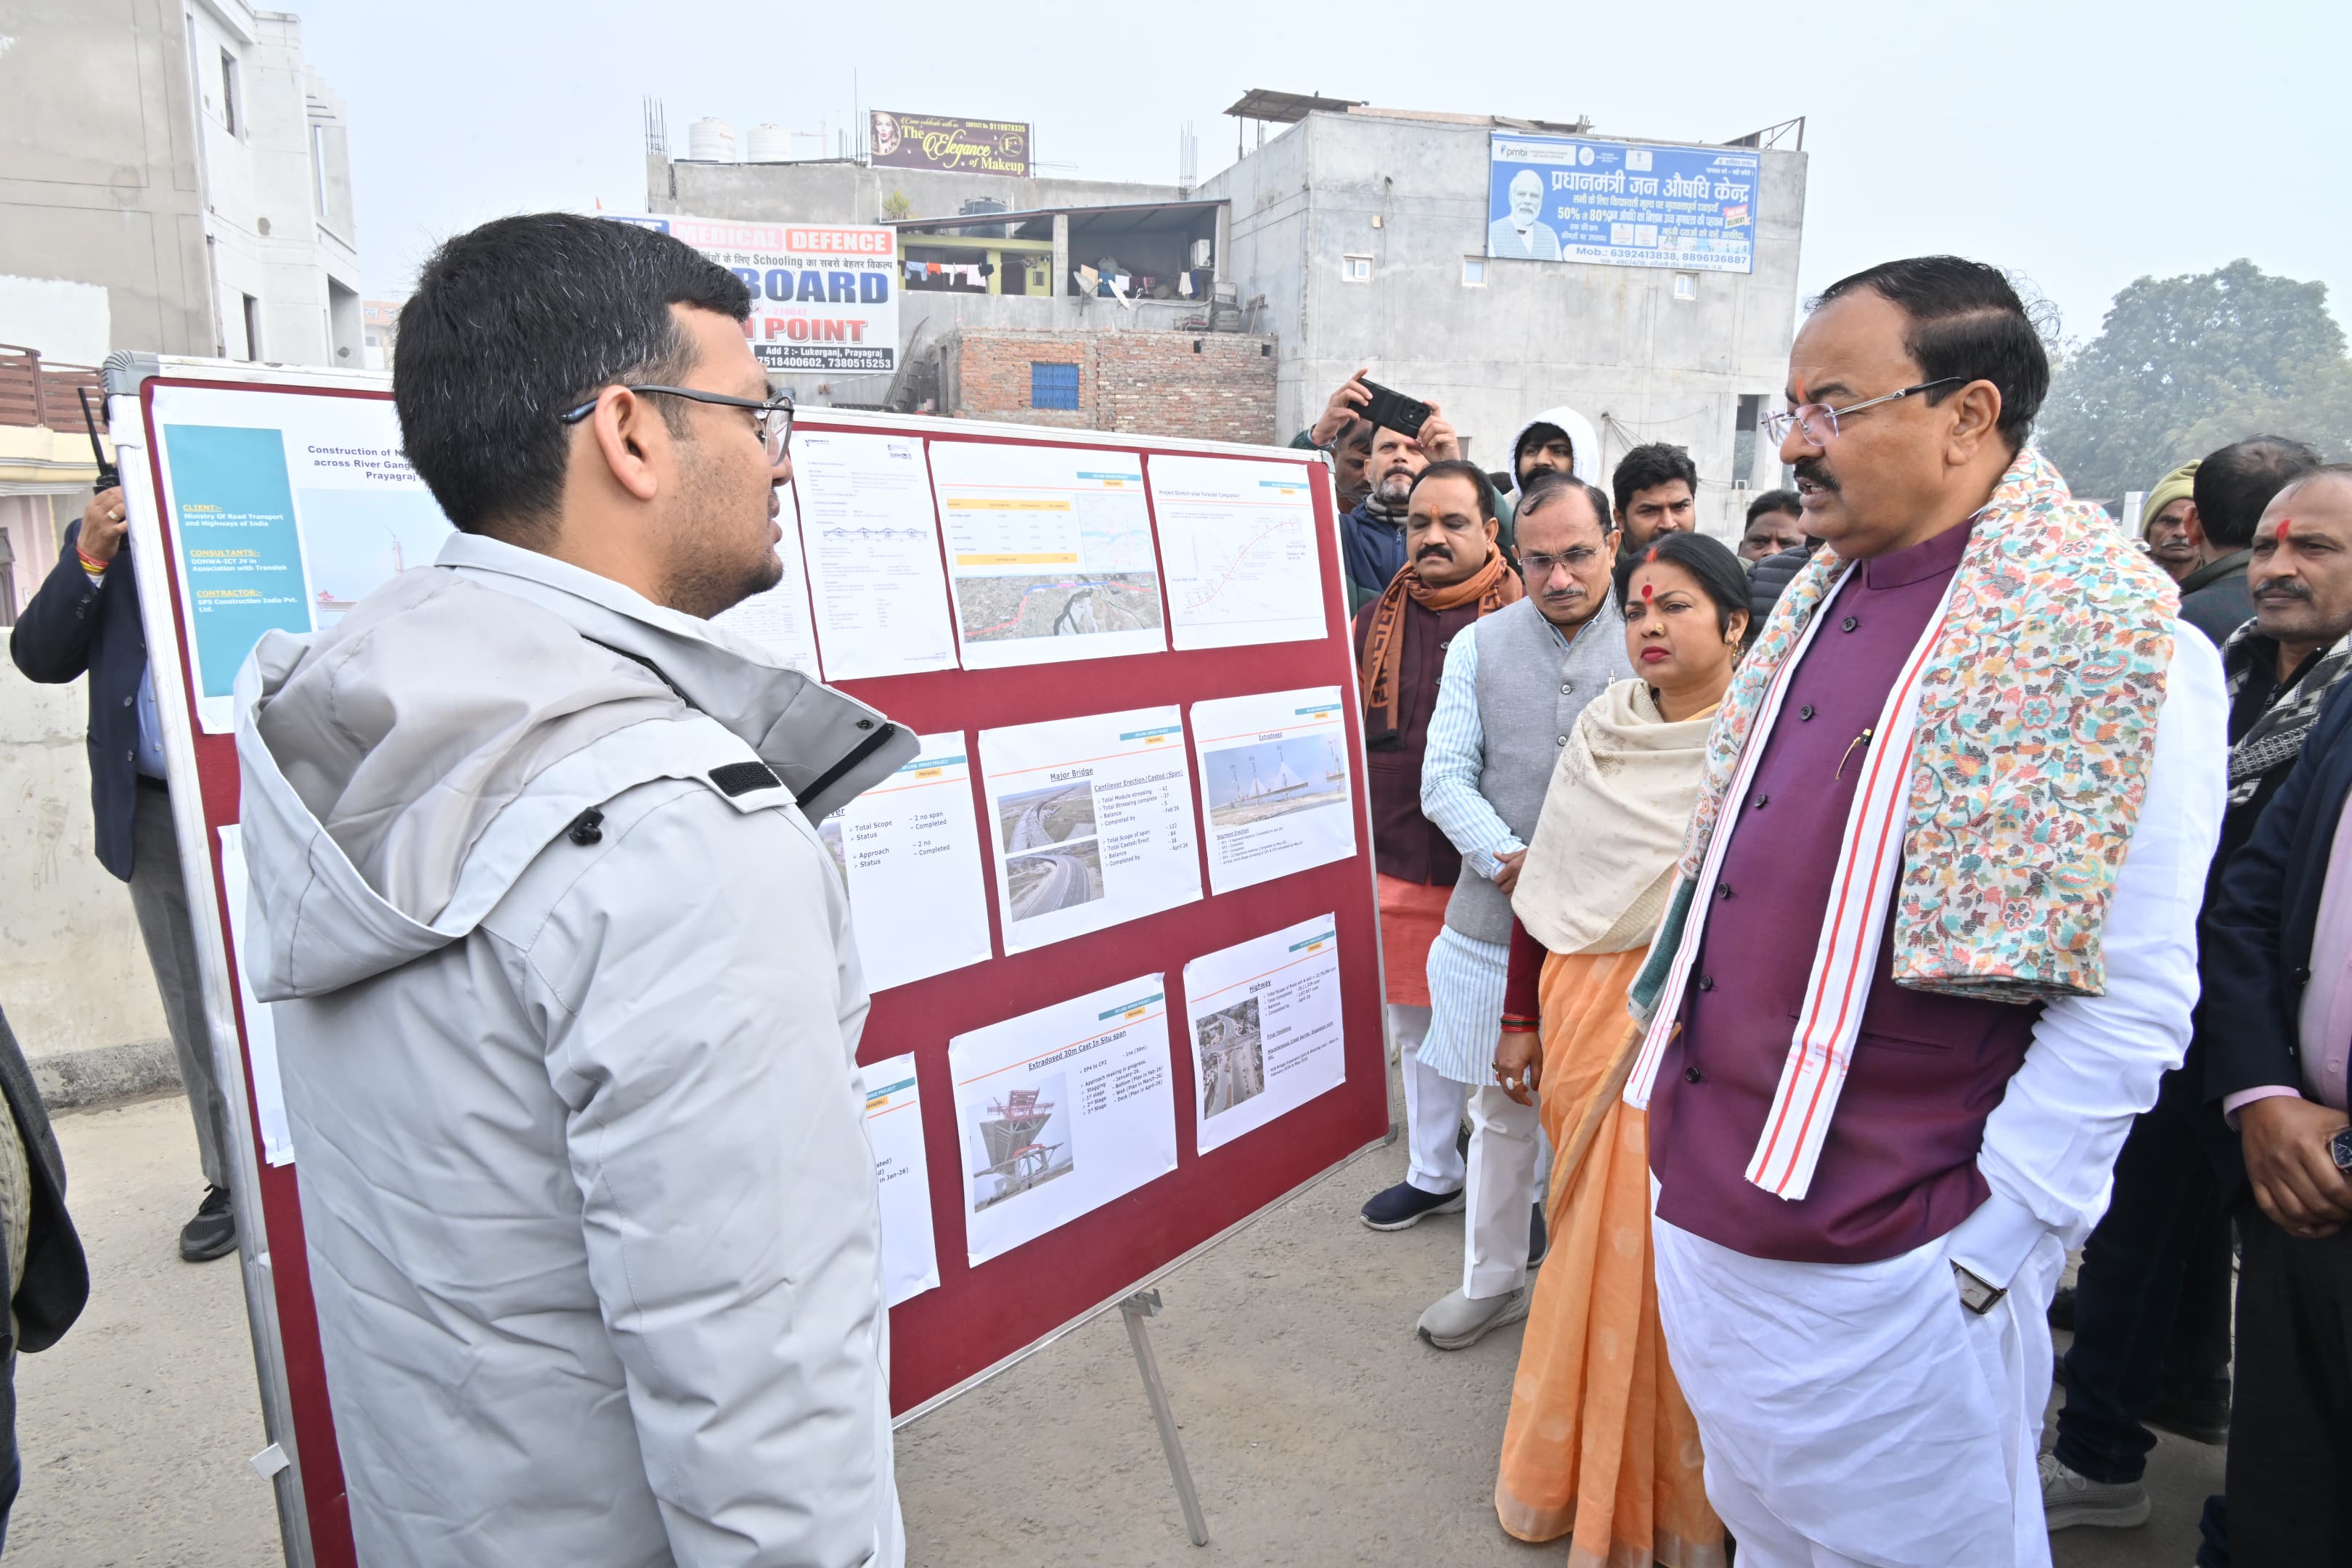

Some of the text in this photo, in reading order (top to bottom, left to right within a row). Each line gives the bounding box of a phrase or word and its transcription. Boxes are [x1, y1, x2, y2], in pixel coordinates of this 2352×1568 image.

[902, 126, 924, 139] The
[923, 129, 991, 168] Elegance
[1506, 147, 1527, 158] pmbi
[970, 157, 1024, 173] of Makeup
[1551, 170, 1625, 194] प्रधानमंत्री
[1629, 177, 1658, 196] जन
[1663, 172, 1710, 199] औषधि
[1558, 207, 1612, 221] 50% 80%
[673, 222, 779, 248] MEDICAL
[792, 232, 886, 252] DEFENCE
[735, 256, 750, 264] लिए
[754, 254, 802, 268] Schooling
[806, 258, 817, 267] का
[820, 258, 839, 267] सबसे
[844, 258, 864, 269] बेहतर
[868, 259, 892, 269] विकल्प
[1683, 253, 1747, 264] 8896136887
[732, 267, 888, 303] BOARD
[764, 318, 867, 343] POINT
[801, 348, 842, 358] Lukerganj,
[845, 348, 882, 358] Prayagraj
[758, 356, 891, 368] 7518400602, 7380515253
[308, 446, 377, 456] Construction
[384, 461, 412, 470] Gang
[367, 472, 416, 481] Prayagraj
[1259, 732, 1283, 741] Extradosed
[1050, 767, 1093, 782] Major Bridge
[1094, 781, 1122, 791] Cantilever
[855, 823, 871, 832] Total
[873, 820, 892, 830] Scope
[929, 811, 943, 820] span
[1105, 817, 1129, 826] Completed
[857, 818, 947, 841] Status Completed
[859, 847, 889, 859] Approach
[860, 844, 950, 868] Status Completed
[1109, 856, 1134, 866] Completed
[1249, 979, 1271, 993] Highway
[1028, 1052, 1063, 1071] Extradosed
[1063, 1048, 1077, 1059] 30m
[1079, 1042, 1091, 1053] Cast
[1101, 1035, 1111, 1045] Situ
[1113, 1029, 1126, 1042] span
[1135, 1045, 1147, 1054] (30m)
[1085, 1075, 1105, 1087] Approach
[1106, 1069, 1122, 1078] making
[1116, 1079, 1130, 1089] Bottom
[886, 1167, 909, 1182] Jan-26)
